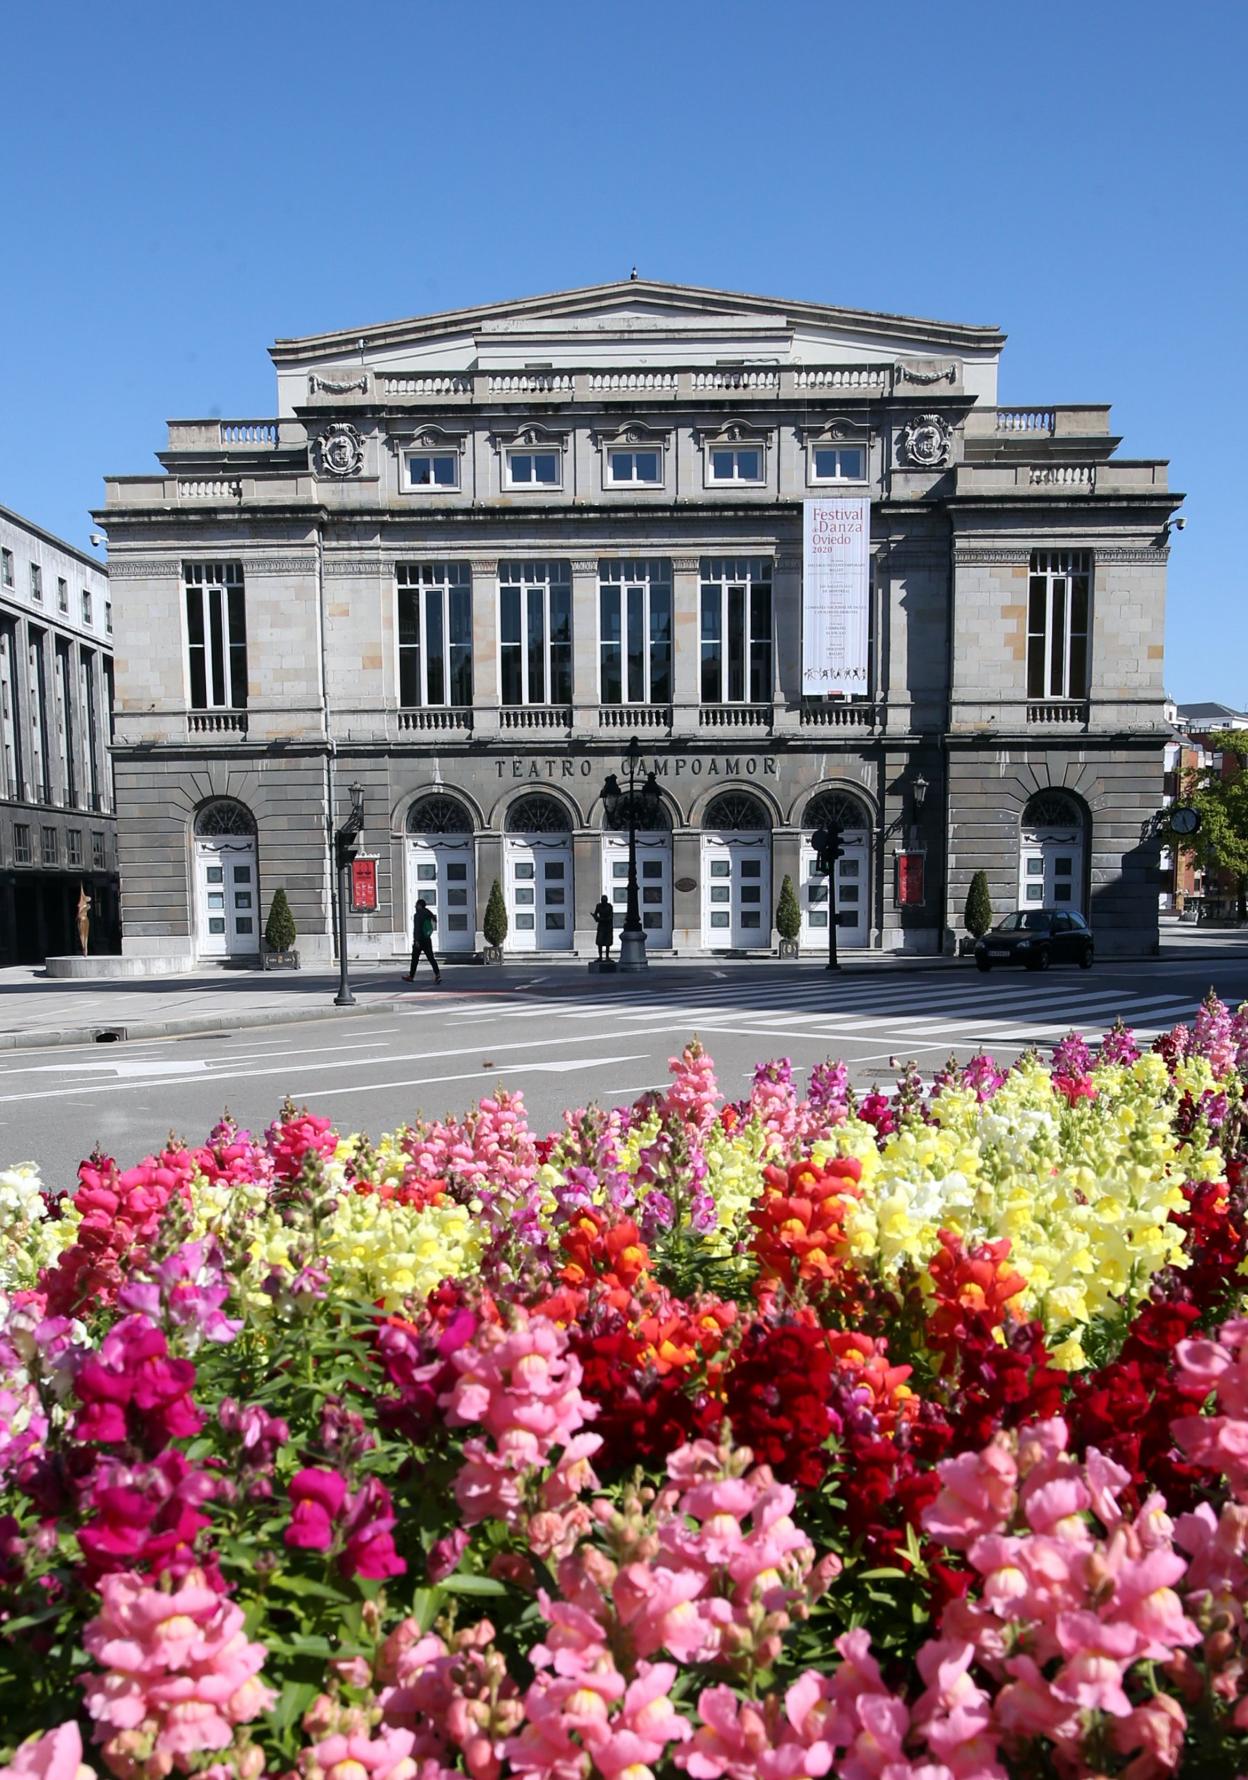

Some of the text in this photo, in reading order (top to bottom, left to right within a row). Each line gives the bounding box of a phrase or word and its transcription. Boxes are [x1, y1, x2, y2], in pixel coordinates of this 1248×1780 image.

[813, 507, 863, 521] Festival
[819, 520, 863, 533] Danza
[812, 533, 851, 545] Oviedo
[812, 546, 833, 554] 2020
[495, 757, 776, 778] TEATRO CAMPOAMOR
